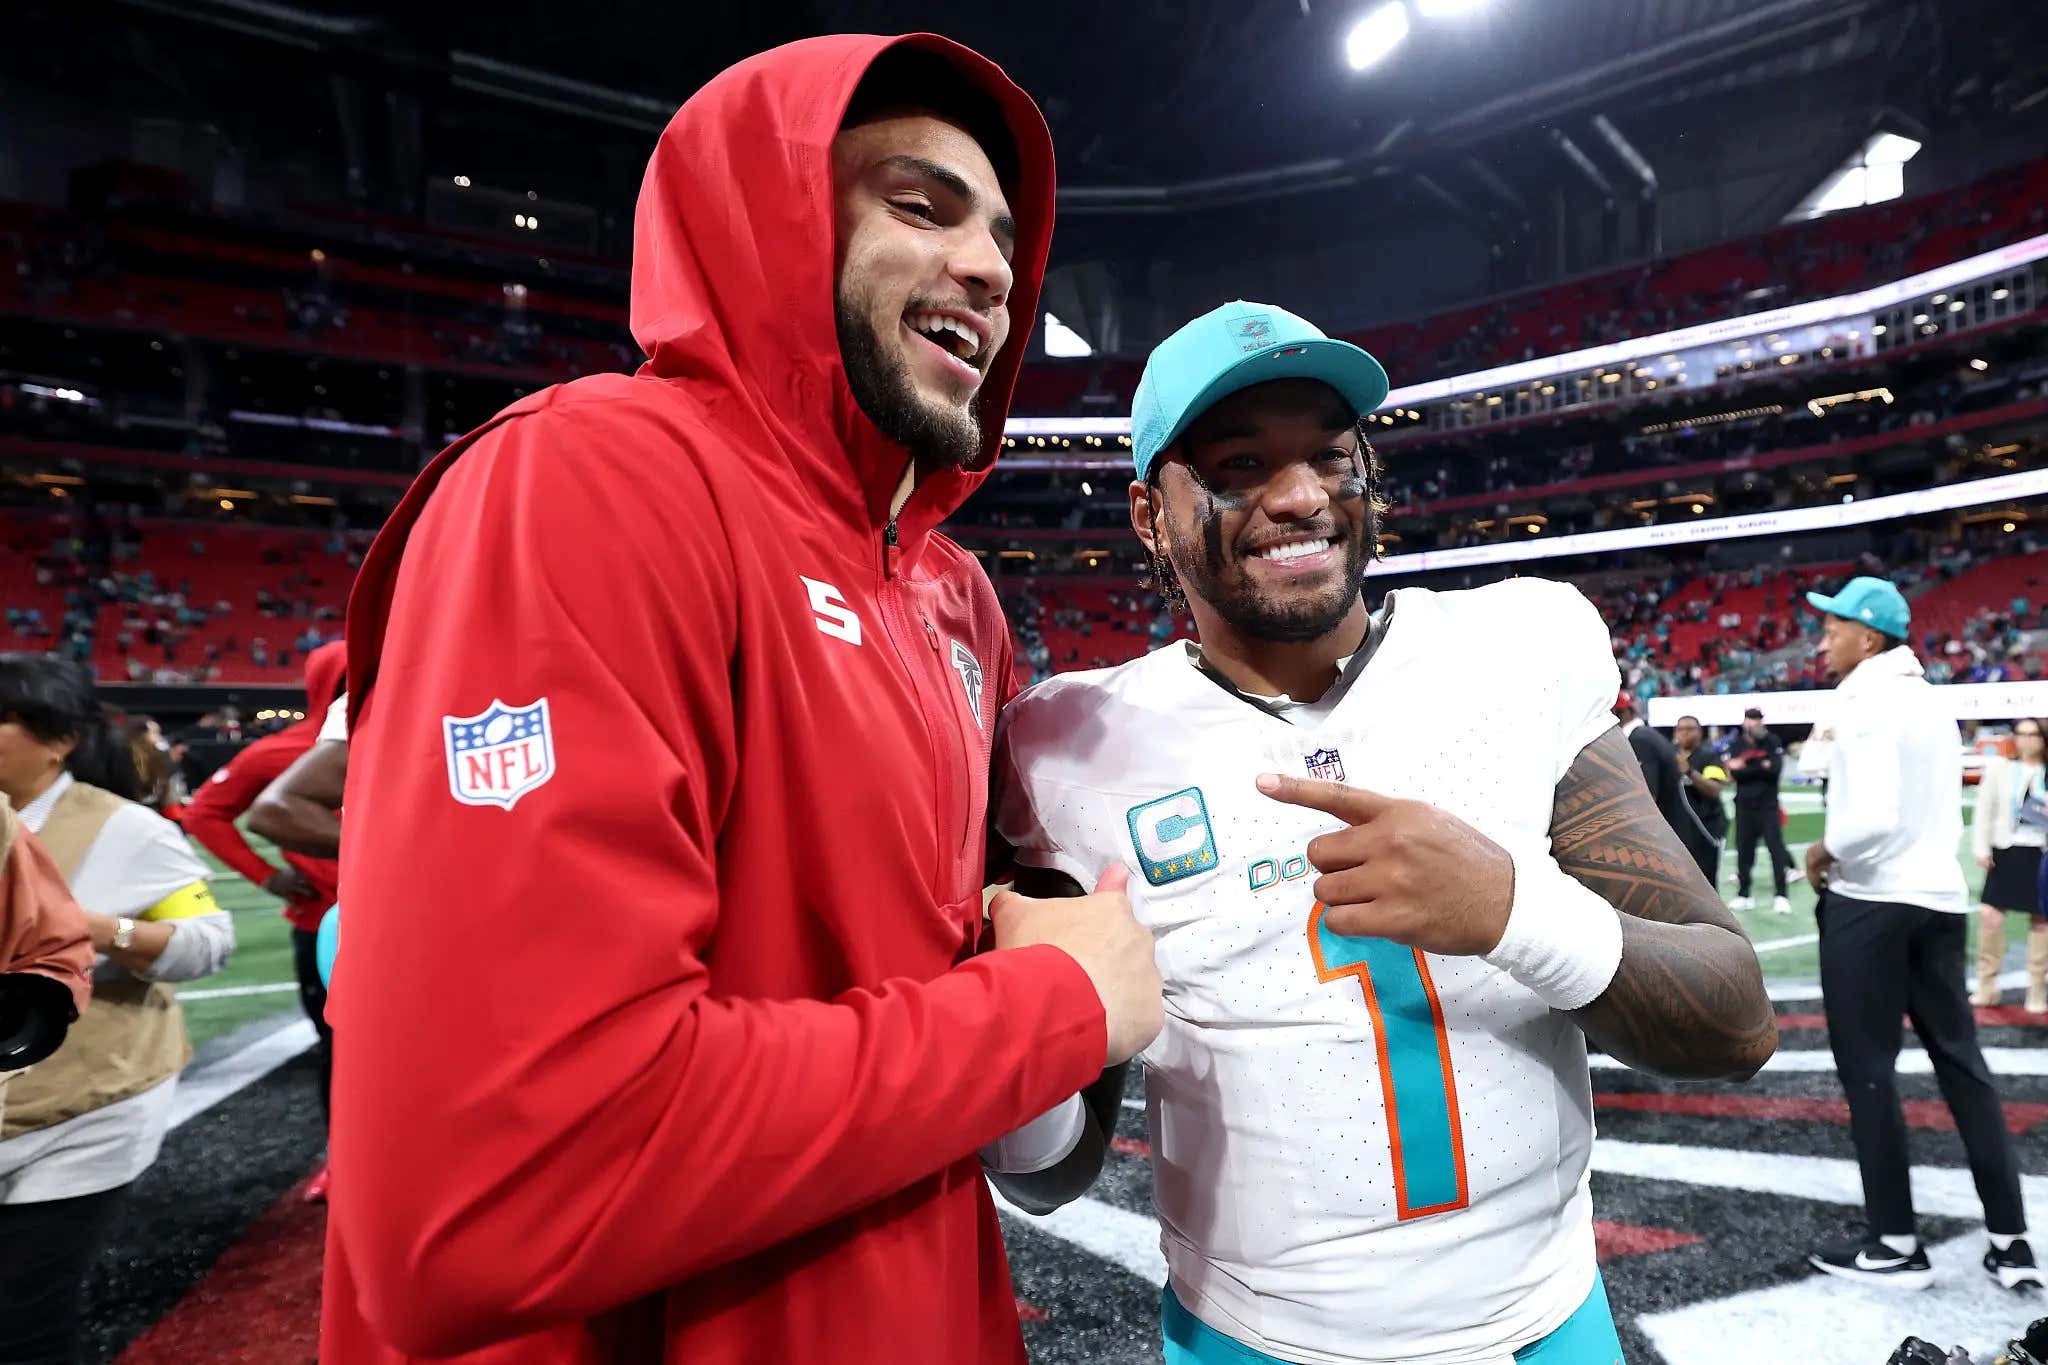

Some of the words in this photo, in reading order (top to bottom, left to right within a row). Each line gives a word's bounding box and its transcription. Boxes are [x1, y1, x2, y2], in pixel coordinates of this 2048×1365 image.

[466, 743, 542, 790] NFL
[1311, 763, 1342, 781] NFL
[1136, 796, 1206, 863] C
[1307, 900, 1469, 1221] 1
